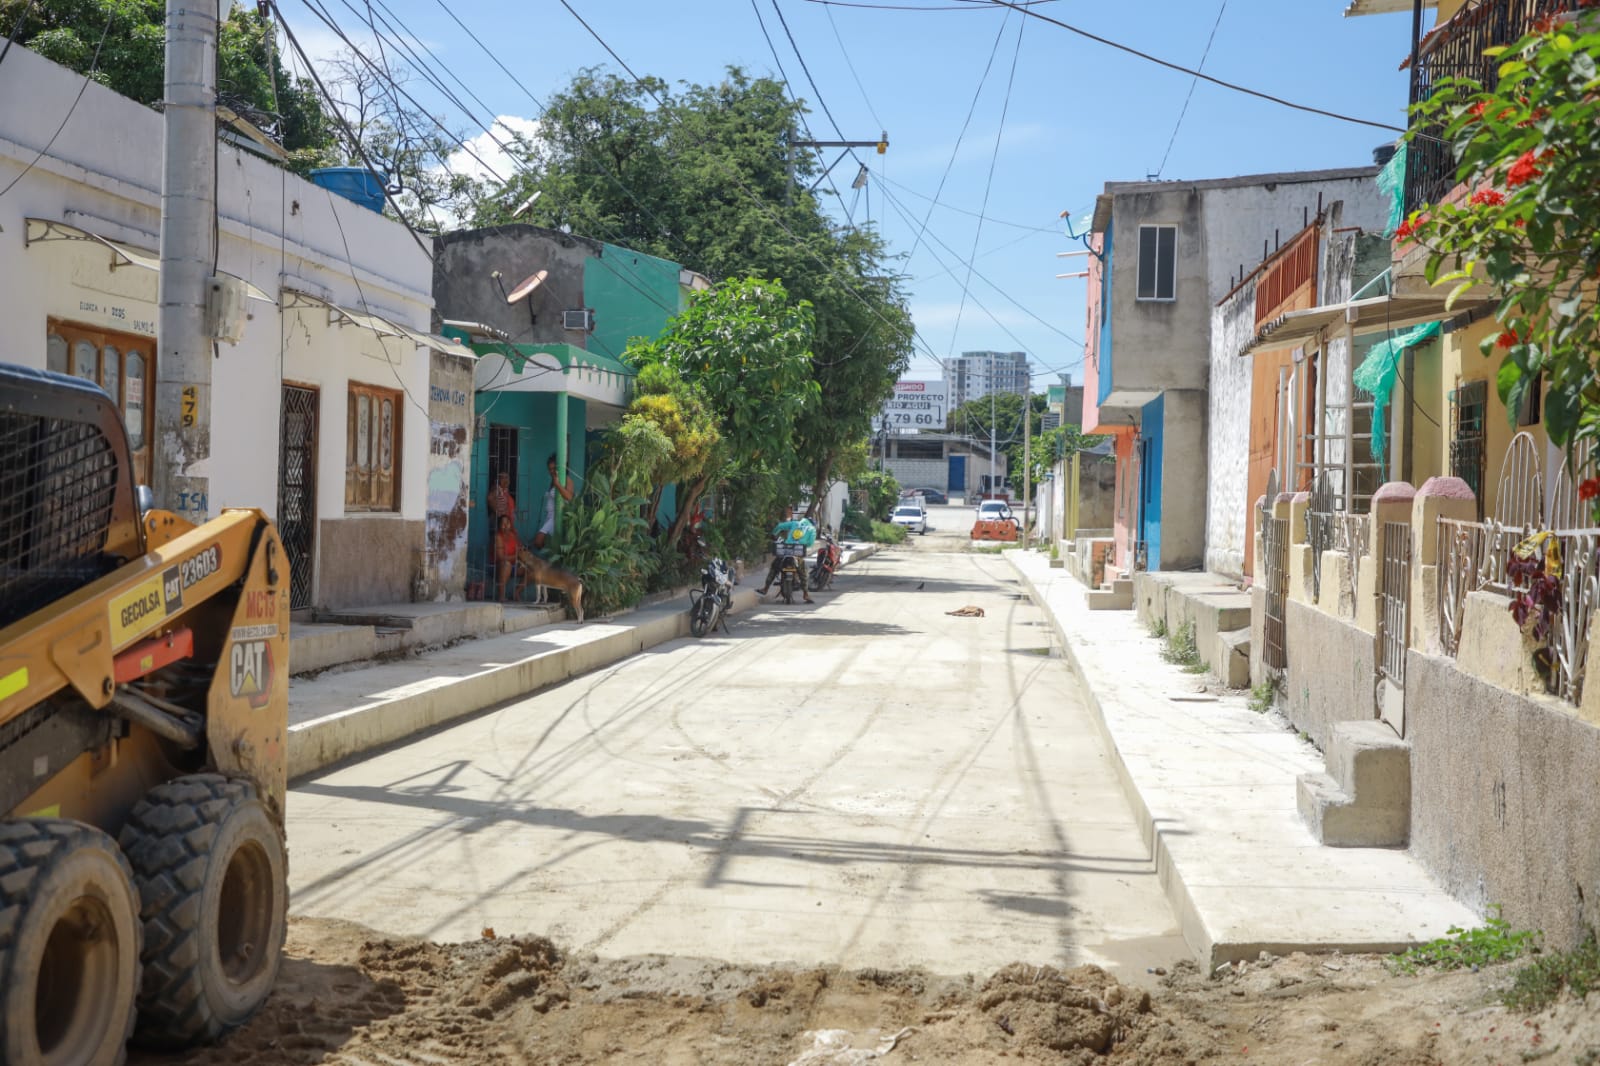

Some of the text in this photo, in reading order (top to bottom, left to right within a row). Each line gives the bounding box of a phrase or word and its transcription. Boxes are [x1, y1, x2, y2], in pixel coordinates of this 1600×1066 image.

[183, 386, 196, 428] 479
[897, 393, 944, 401] PROYECTO
[894, 413, 911, 424] 79
[915, 414, 932, 425] 60
[182, 546, 217, 590] 236D3
[121, 577, 180, 628] GECOLSA CAT
[246, 591, 275, 618] MC13
[231, 640, 266, 696] CAT
